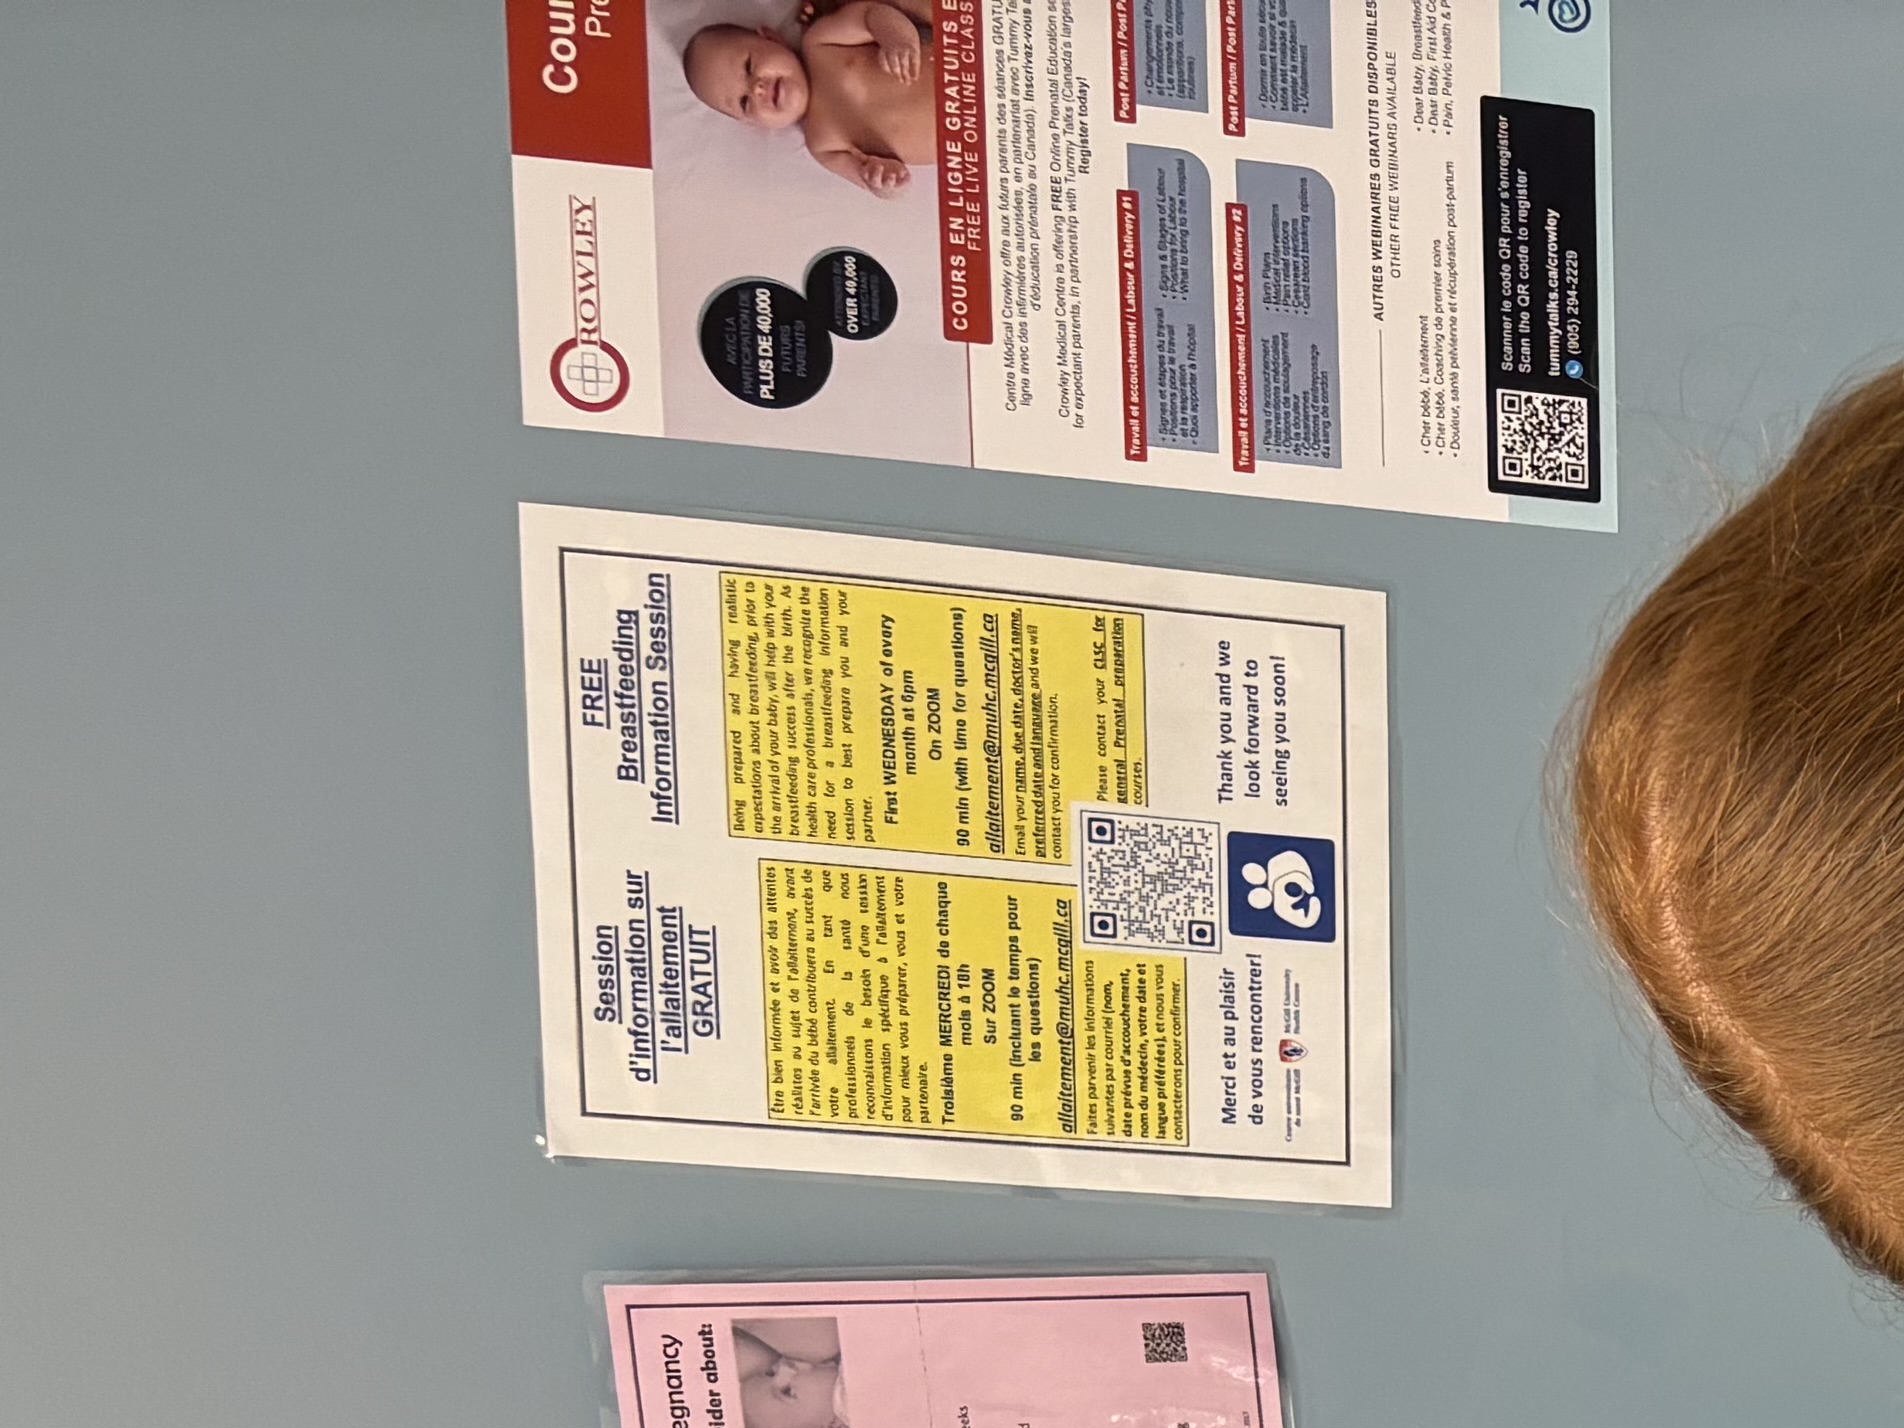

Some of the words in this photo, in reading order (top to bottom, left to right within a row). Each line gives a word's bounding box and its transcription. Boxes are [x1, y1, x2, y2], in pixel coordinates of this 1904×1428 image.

[942, 21, 962, 131] GRATUITS
[961, 71, 978, 144] ONLINE
[945, 140, 964, 208] LIGNE
[963, 151, 980, 194] LIVE
[1515, 168, 1531, 224] register
[948, 217, 965, 245] EN
[965, 201, 982, 252] FREE
[1516, 227, 1529, 241] to
[843, 255, 859, 296] 40,000
[1516, 245, 1530, 281] code
[1564, 250, 1579, 316] 294-2229
[754, 288, 774, 335] 40,000
[949, 255, 968, 331] COURS
[1516, 283, 1530, 308] QR
[1543, 208, 1563, 377] tummytalks.ca/crowley
[845, 297, 859, 334] OVER
[1517, 311, 1531, 334] the
[1565, 318, 1582, 355] (905)
[756, 335, 773, 358] DE
[1517, 337, 1532, 374] Scan
[757, 359, 775, 401] PLUS
[643, 571, 669, 673] Session
[880, 613, 896, 659] every
[878, 660, 894, 678] of
[1217, 640, 1231, 668] we
[1243, 659, 1259, 679] to
[579, 657, 604, 728] FREE
[611, 609, 639, 783] Breastfeeding
[900, 669, 917, 704] 6pm
[1213, 672, 1232, 707] and
[1268, 655, 1286, 707] soon!
[901, 707, 915, 723] at
[925, 687, 942, 735] ZOOM
[1219, 711, 1237, 745] you
[1241, 684, 1260, 755] forward
[1273, 711, 1290, 745] you
[647, 680, 674, 824] Information
[879, 683, 897, 787] WEDNESDAY
[900, 726, 917, 776] month
[927, 739, 943, 761] On
[1215, 749, 1233, 805] Thank
[1242, 759, 1261, 799] look
[1270, 748, 1291, 808] seeing
[883, 791, 899, 825] First
[623, 869, 648, 911] sur
[935, 881, 952, 937] chaque
[935, 940, 950, 959] de
[590, 925, 617, 1023] Session
[655, 905, 683, 1053] l'allaitement
[687, 923, 715, 1038] GRATUIT
[955, 963, 971, 990] 18h
[980, 968, 996, 1015] ZOOM
[1218, 967, 1240, 1022] plaisir
[625, 917, 652, 1083] d'information
[935, 964, 953, 1048] MERCREDI
[956, 995, 971, 1005] à
[1245, 953, 1263, 1054] rencontrer!
[957, 1009, 973, 1047] mois
[982, 1017, 997, 1045] Sur
[1222, 1025, 1236, 1048] au
[1221, 1051, 1237, 1071] et
[1250, 1057, 1264, 1100] vous
[939, 1053, 955, 1126] Troisième
[1219, 1075, 1237, 1125] Merci
[1246, 1103, 1264, 1126] de
[696, 1323, 719, 1385] about:
